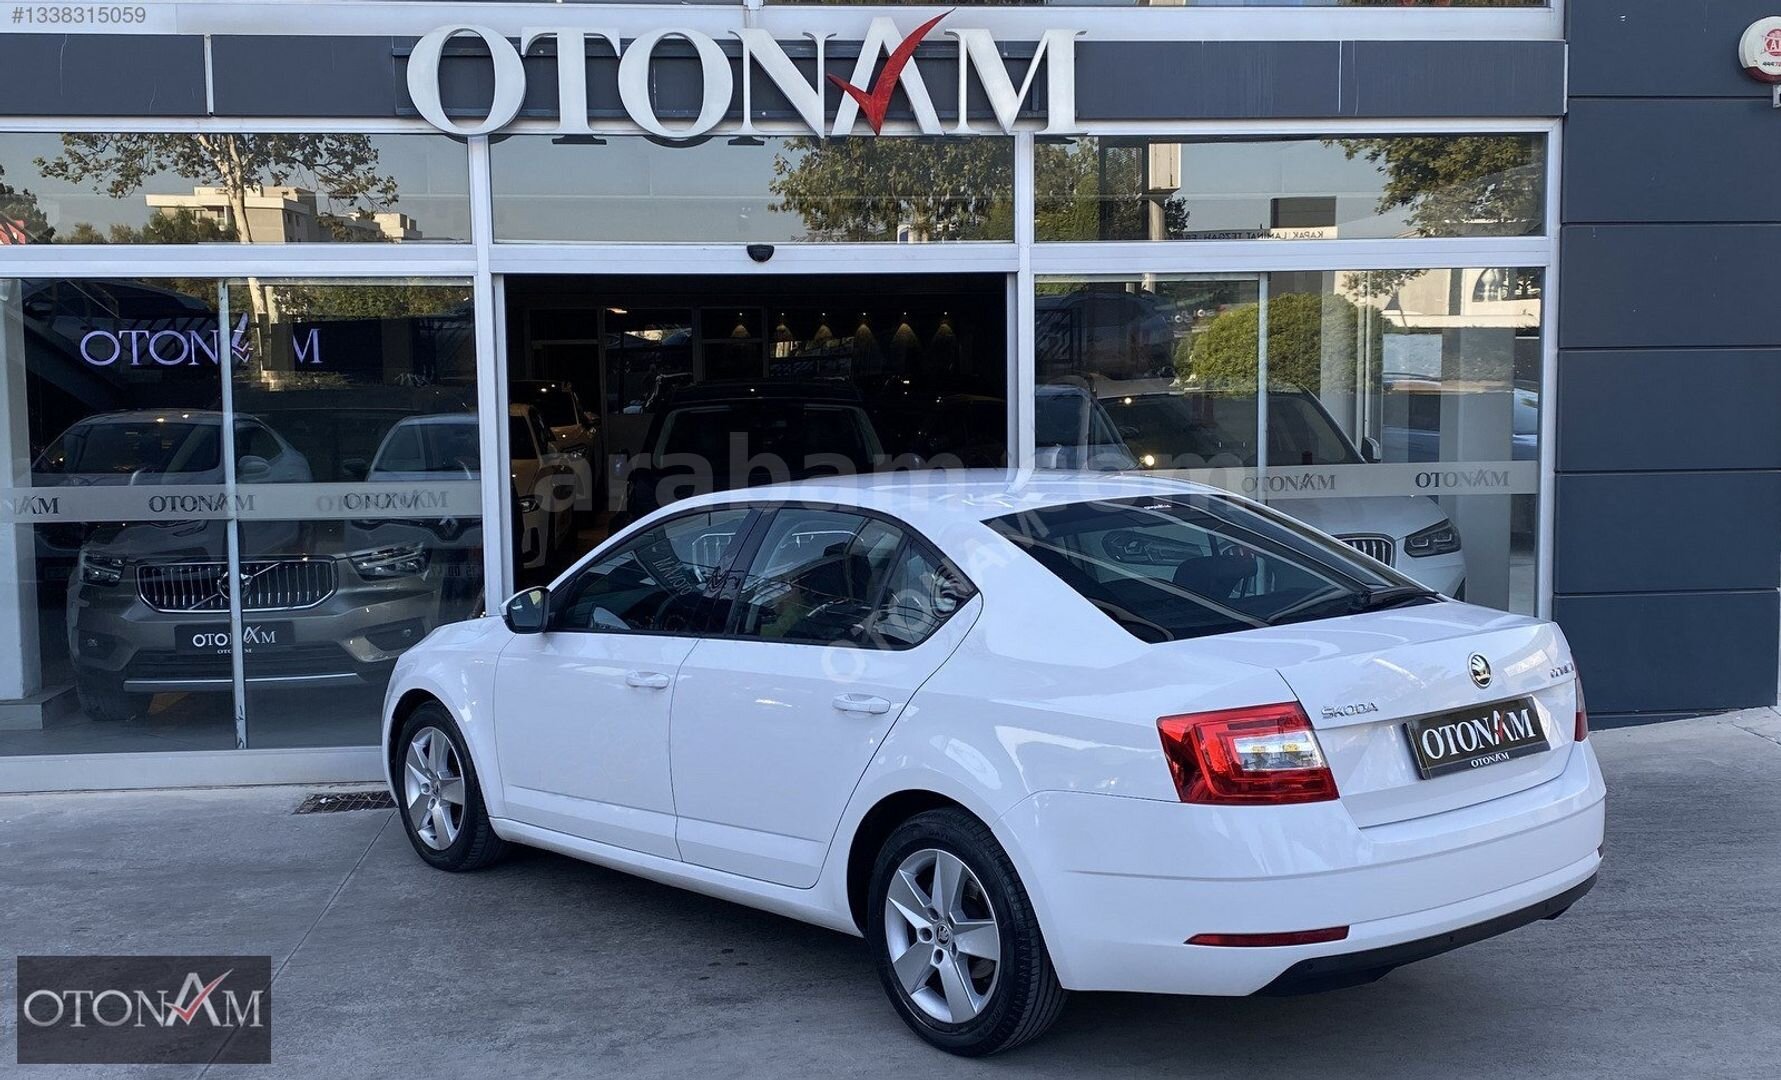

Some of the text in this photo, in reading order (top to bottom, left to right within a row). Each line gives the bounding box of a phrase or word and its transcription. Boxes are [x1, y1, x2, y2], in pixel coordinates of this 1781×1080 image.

[407, 9, 1086, 138] OTONAM
[1415, 469, 1511, 489] OTONAM
[1422, 709, 1537, 760] OTONAM
